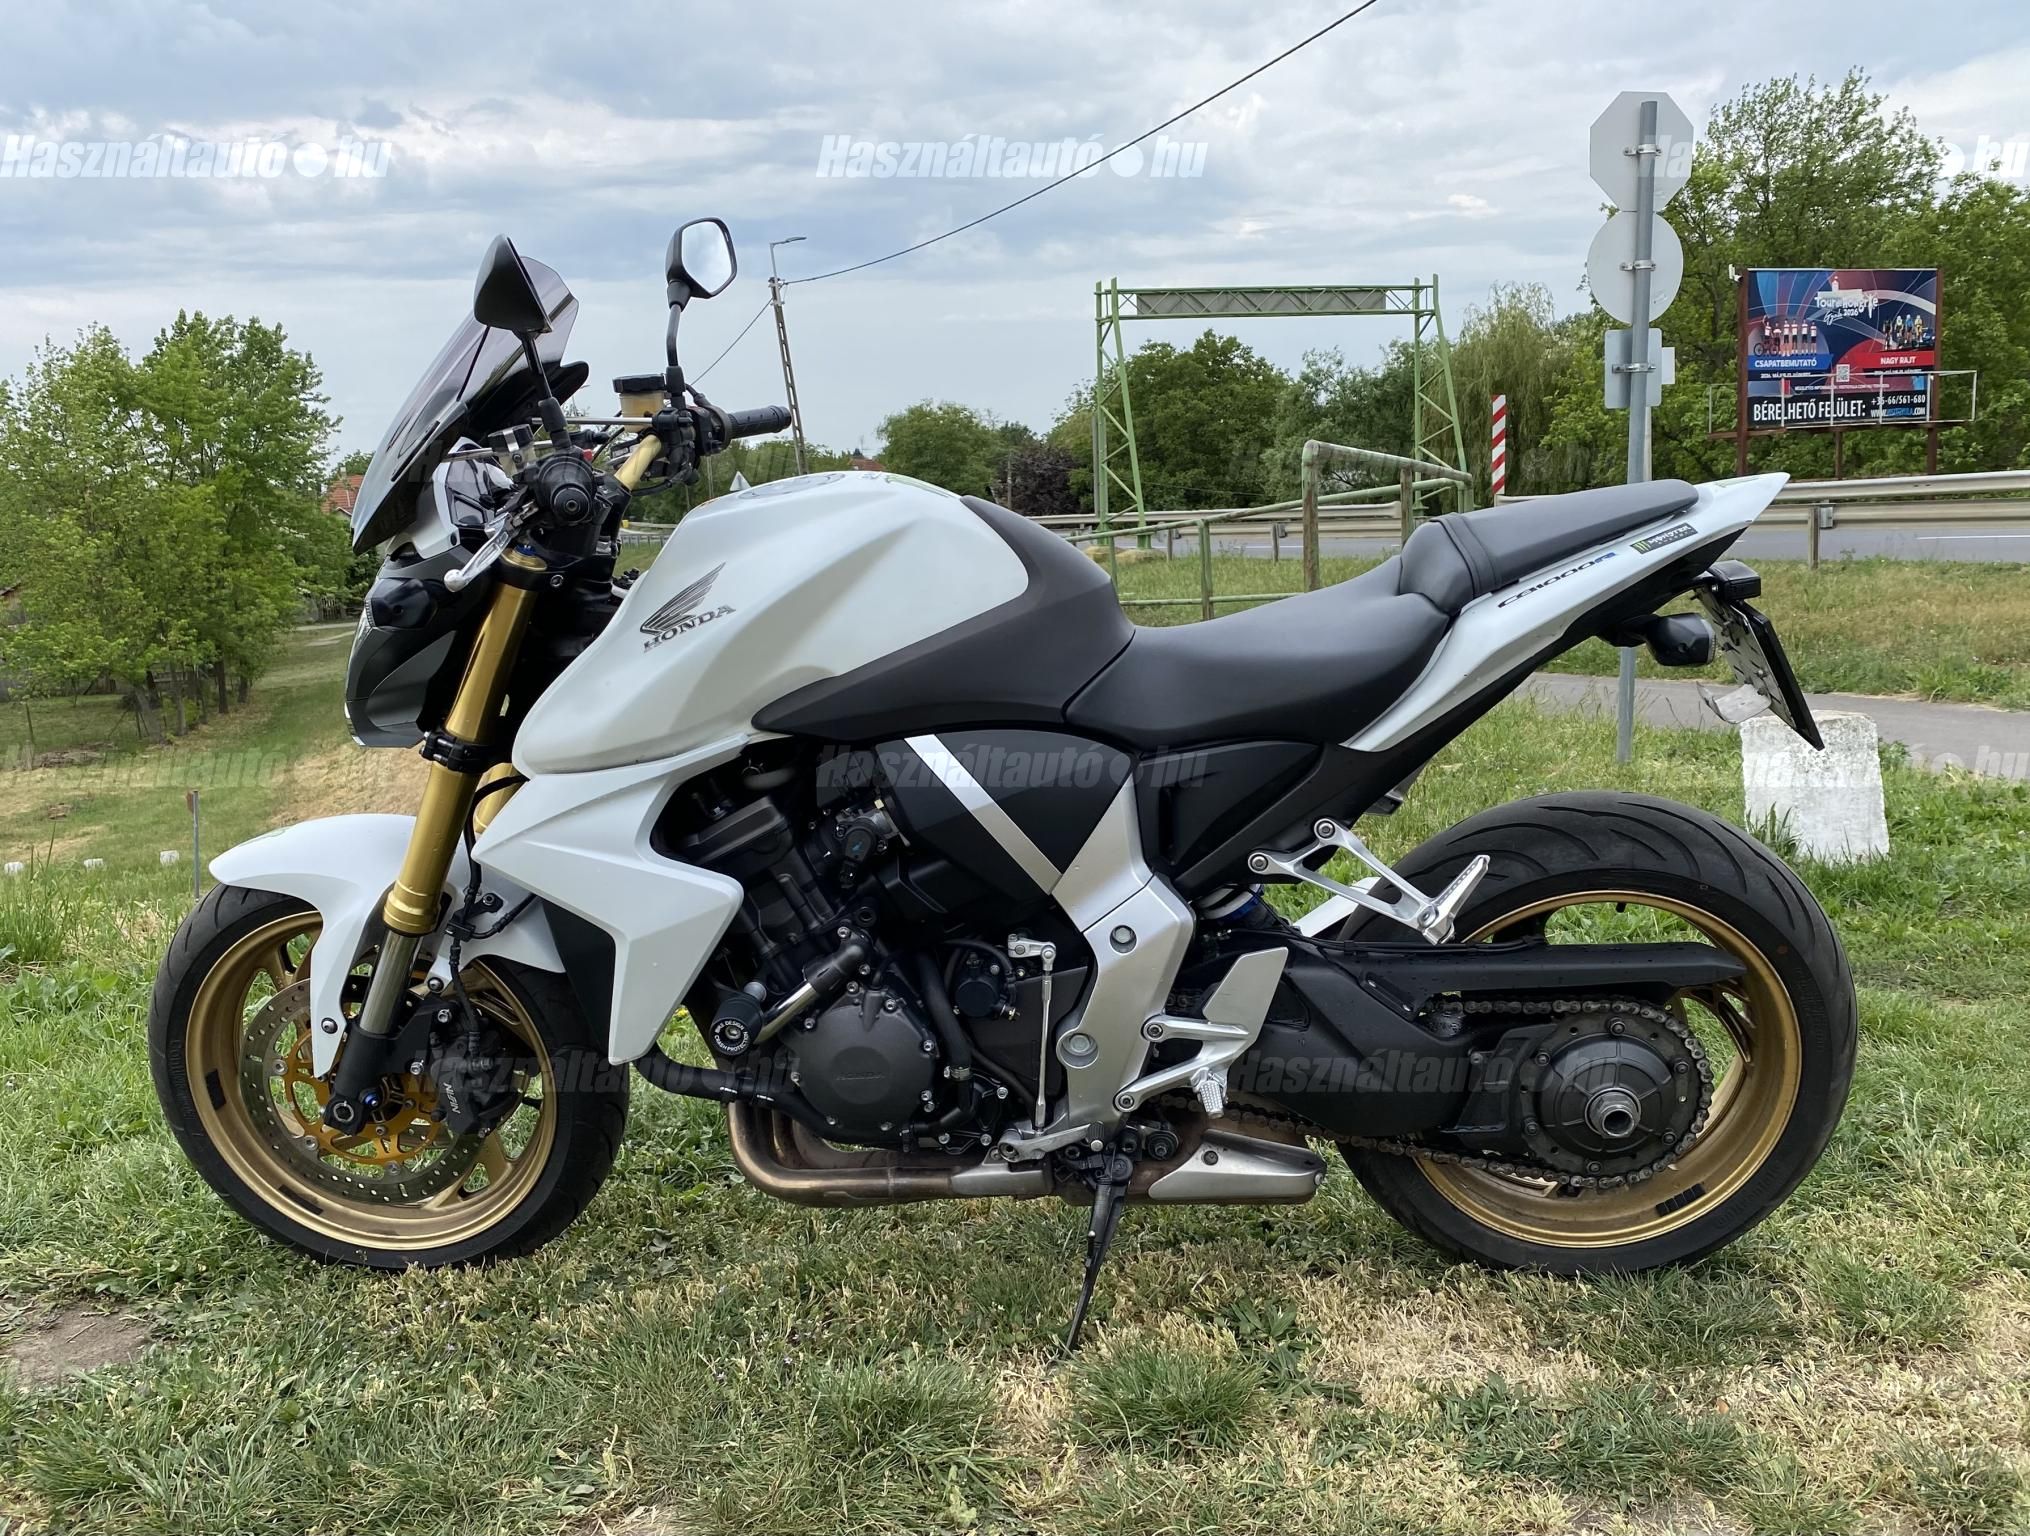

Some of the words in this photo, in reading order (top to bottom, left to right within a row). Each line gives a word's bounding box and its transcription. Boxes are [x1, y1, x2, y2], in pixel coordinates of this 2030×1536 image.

[1755, 359, 1817, 368] CSAPATBEMUTATÓ
[1880, 357, 1899, 365] NAGY
[643, 604, 737, 652] HONDA
